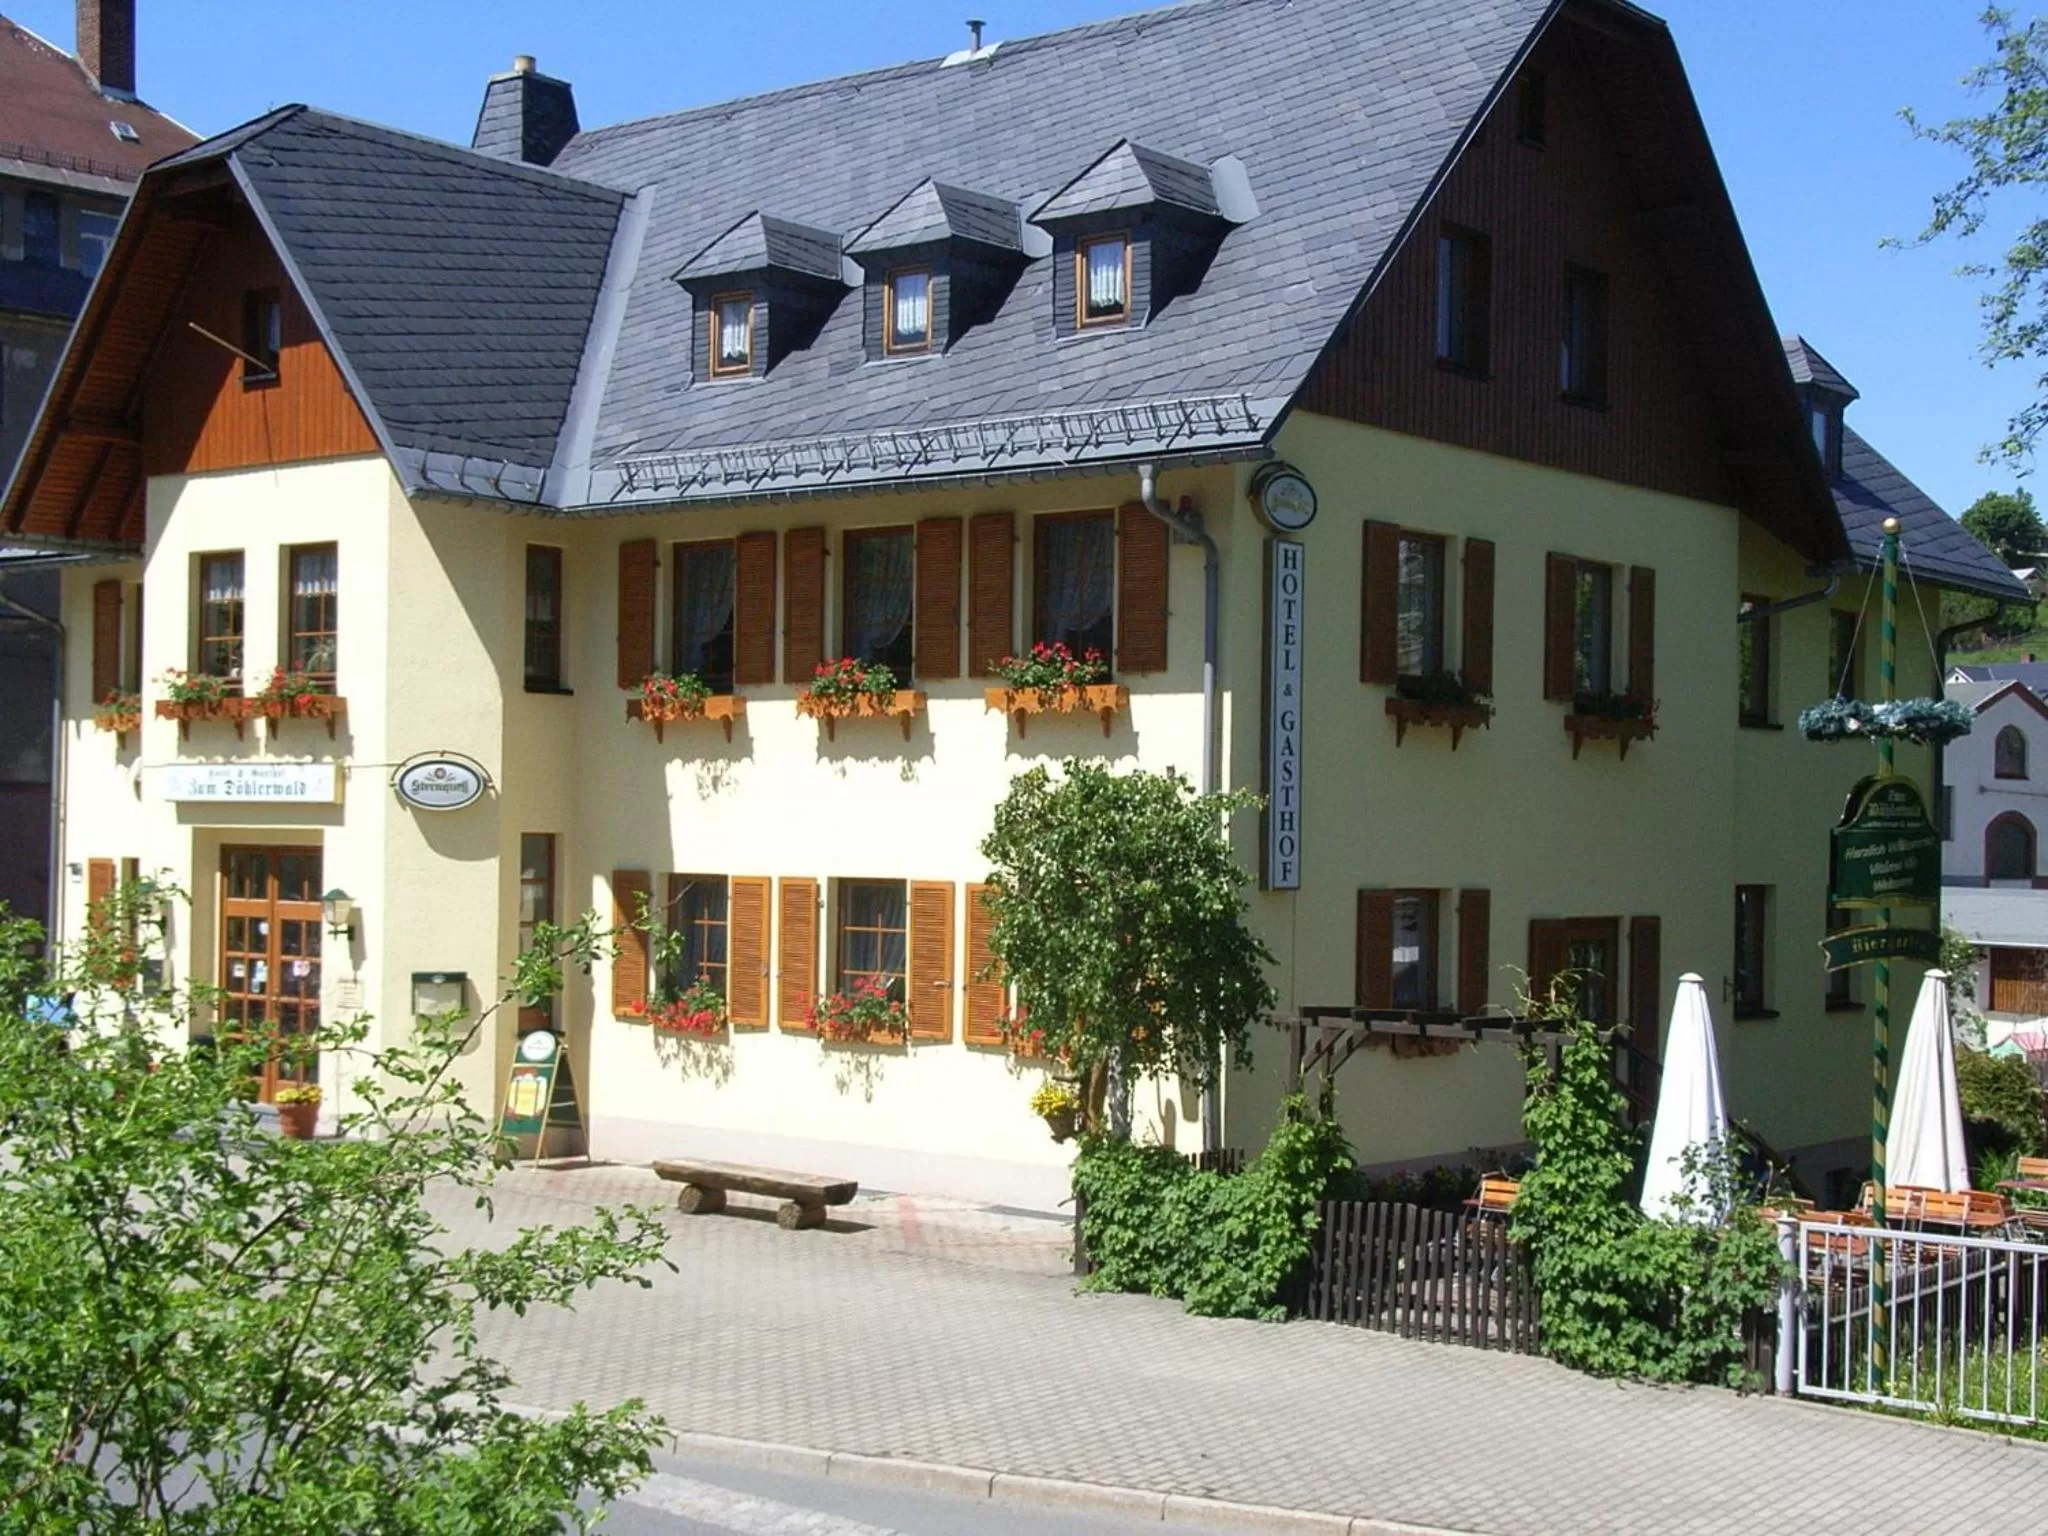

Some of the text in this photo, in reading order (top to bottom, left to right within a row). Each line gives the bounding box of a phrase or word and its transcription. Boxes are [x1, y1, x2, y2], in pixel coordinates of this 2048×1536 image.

[188, 778, 307, 797] Zum Döhlerwald
[1279, 547, 1298, 882] HOTEL & GASTHOF
